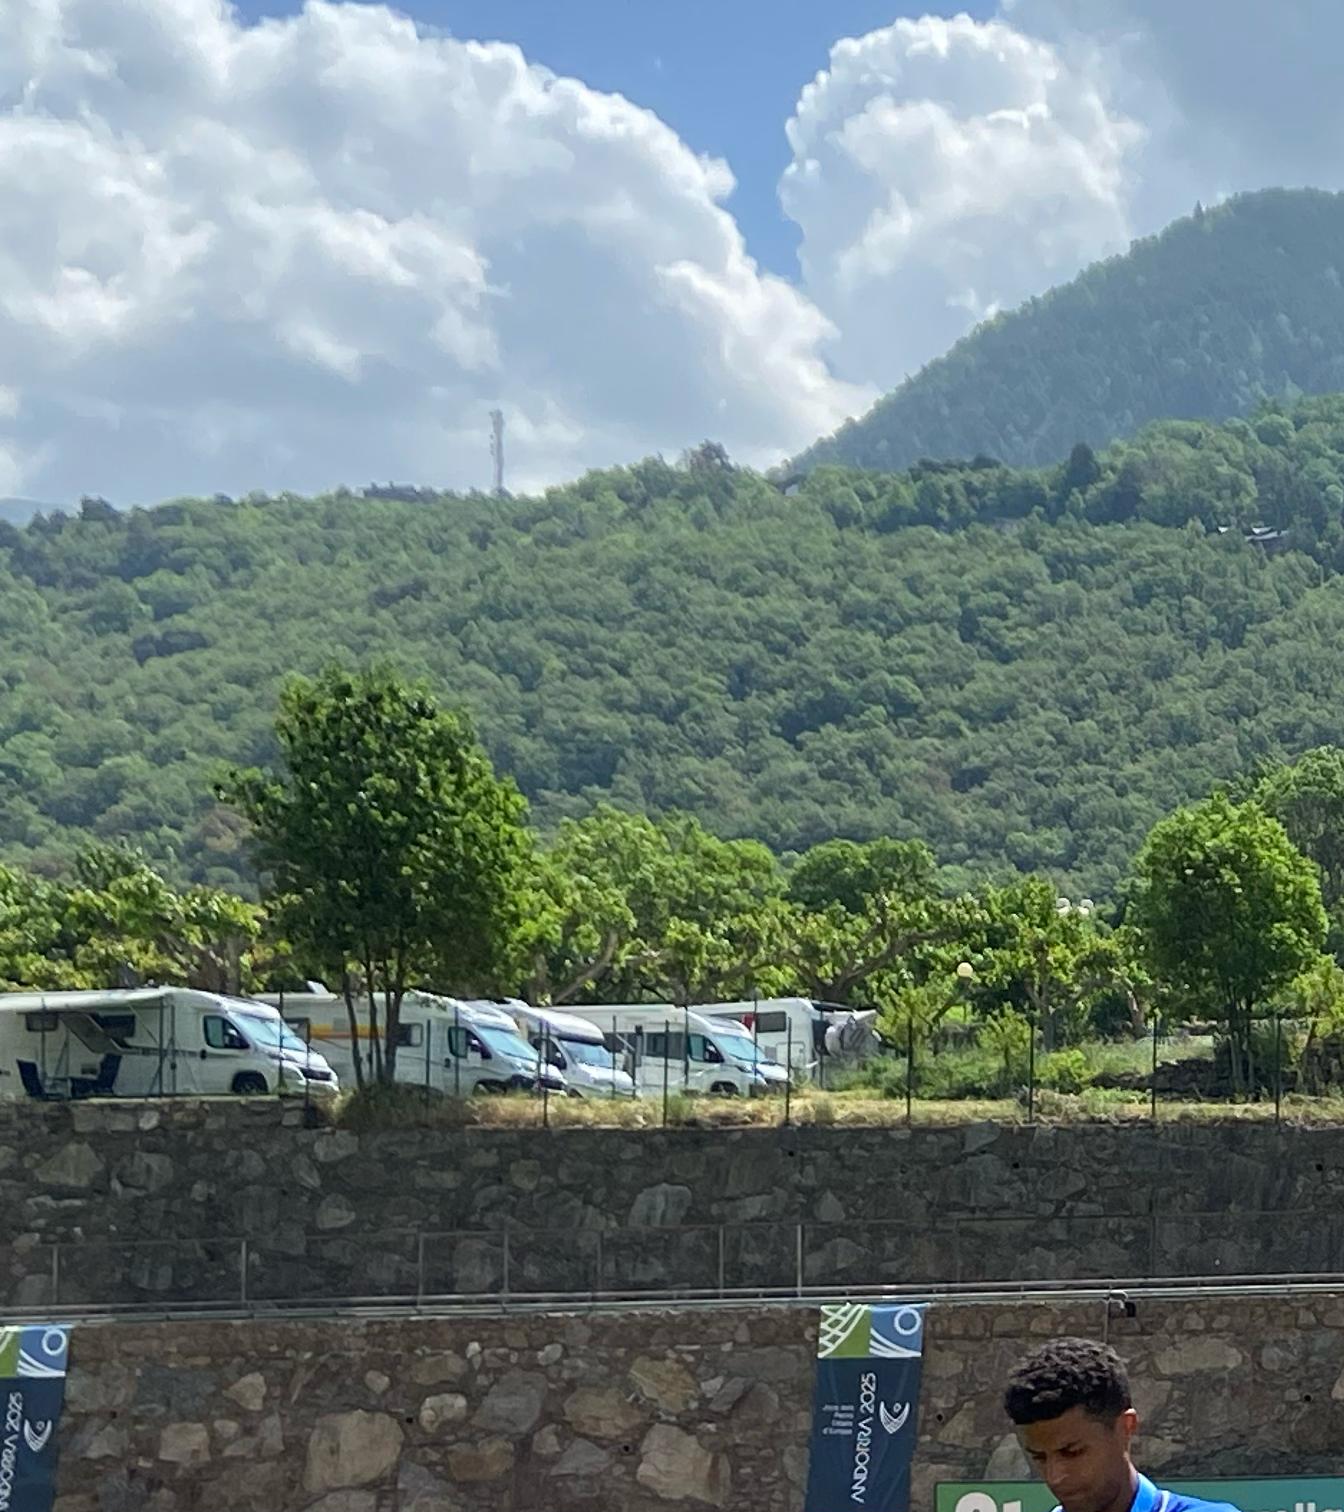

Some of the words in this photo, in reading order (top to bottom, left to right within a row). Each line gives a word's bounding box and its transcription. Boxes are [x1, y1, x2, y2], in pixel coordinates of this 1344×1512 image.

[6, 1392, 22, 1432] 2025
[860, 1372, 876, 1413] 2025
[851, 1417, 874, 1503] ANDORRA
